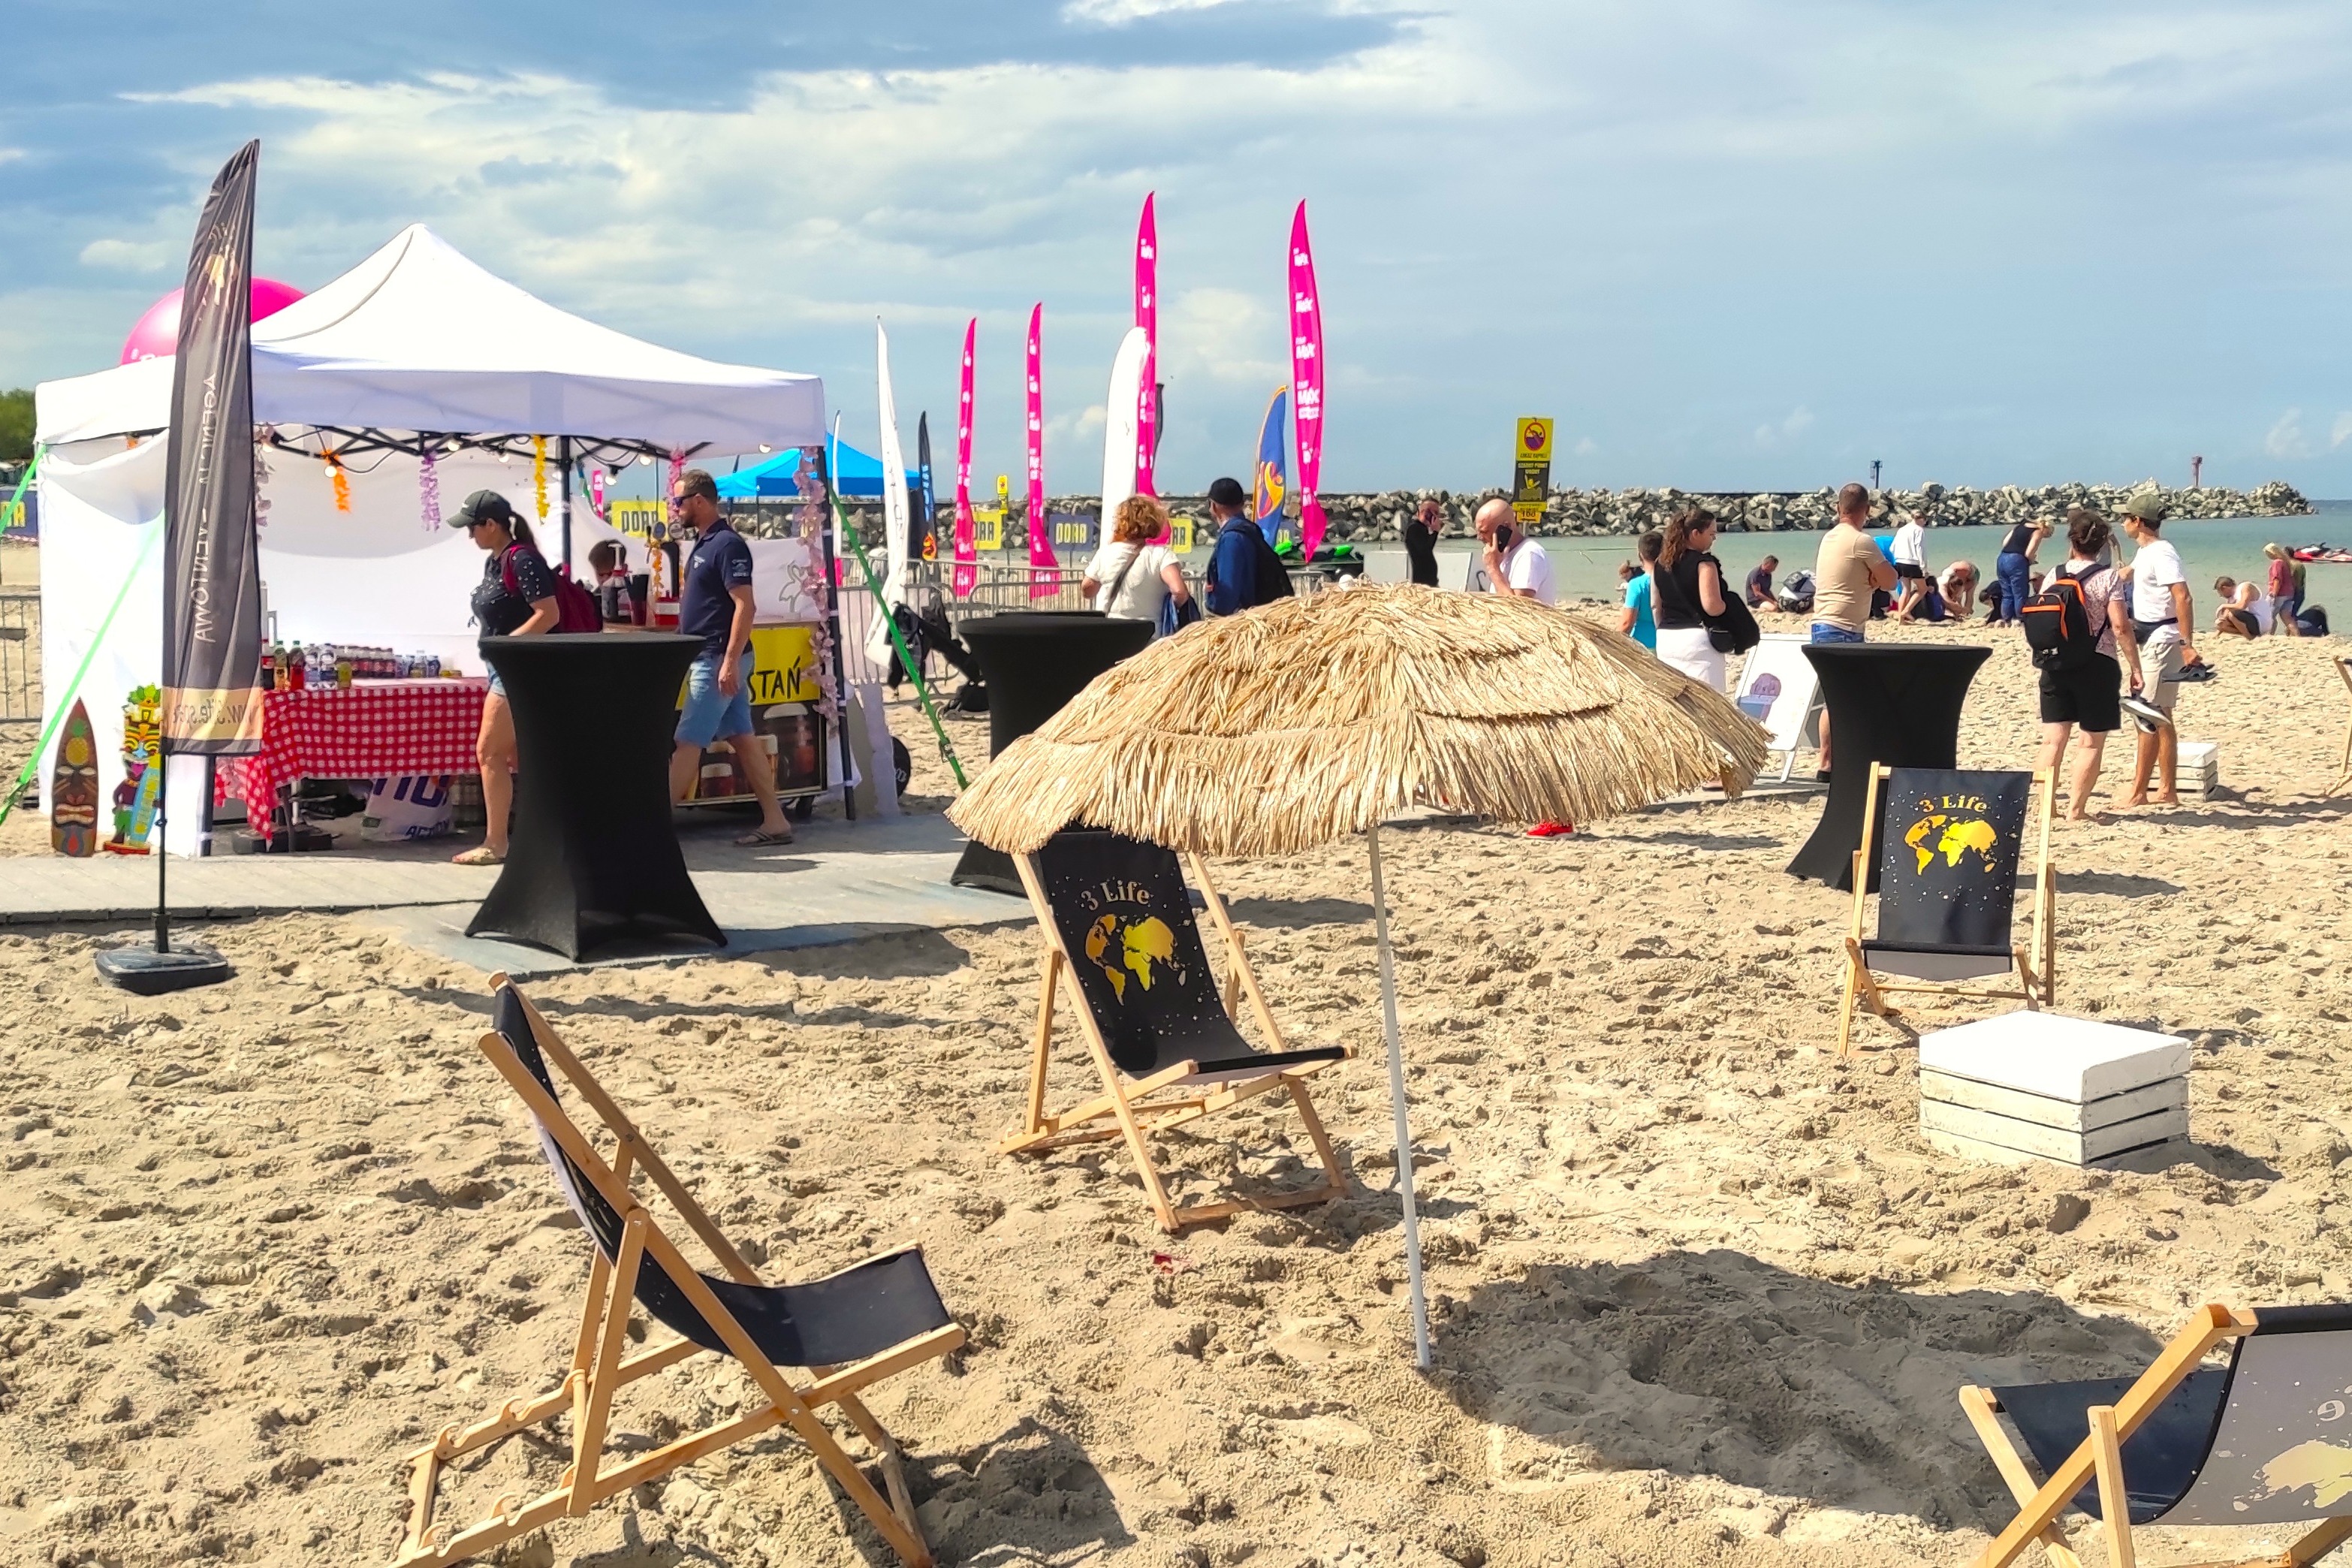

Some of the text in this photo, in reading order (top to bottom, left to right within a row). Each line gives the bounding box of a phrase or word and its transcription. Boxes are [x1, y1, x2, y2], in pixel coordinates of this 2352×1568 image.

[1919, 795, 1988, 813] 3 Life
[1081, 879, 1150, 911] 3 Life
